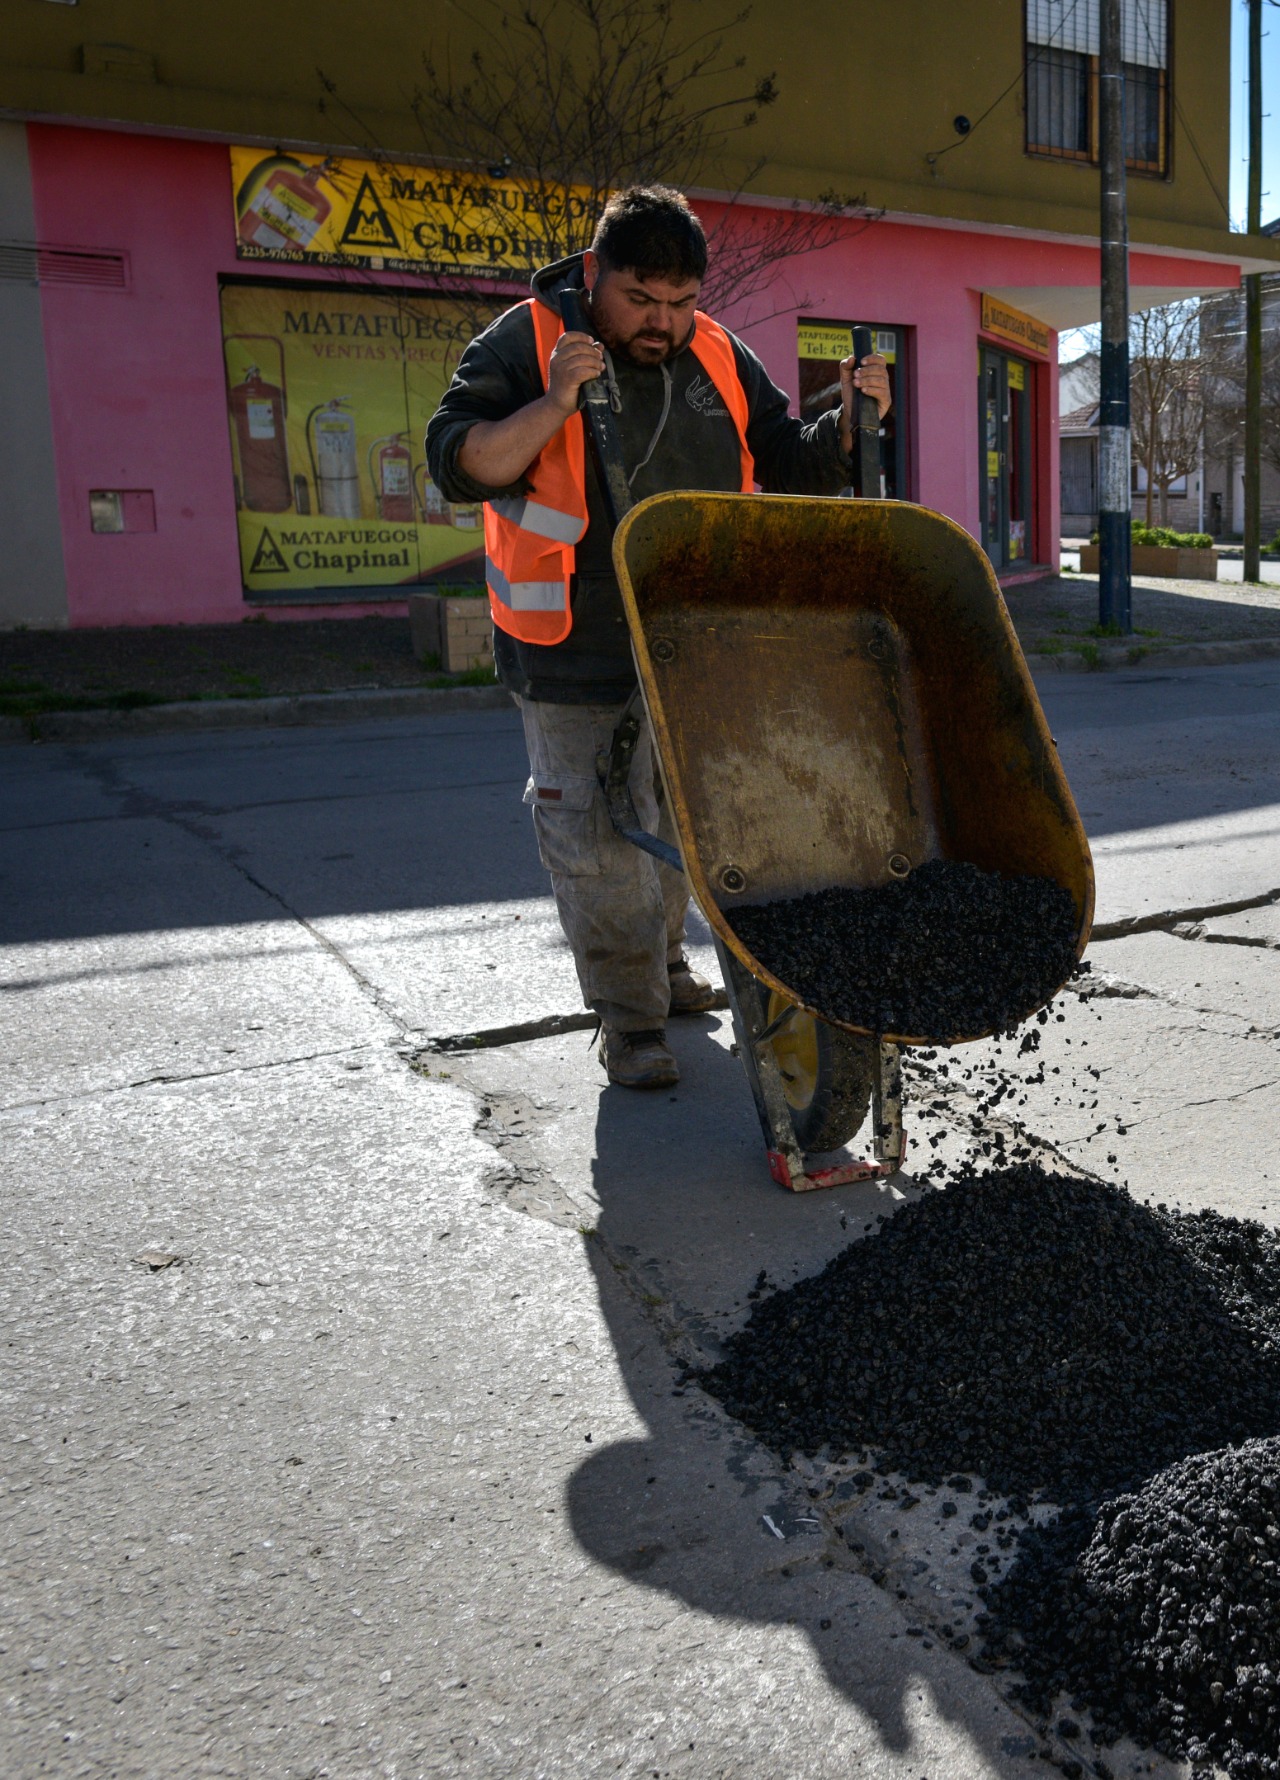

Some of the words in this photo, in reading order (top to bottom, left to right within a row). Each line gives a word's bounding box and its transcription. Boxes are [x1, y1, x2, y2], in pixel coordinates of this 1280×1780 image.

[389, 176, 603, 219] MATAFUEGOS
[797, 331, 849, 342] ATAFUEGOS
[313, 343, 386, 360] VENTAS
[393, 346, 405, 361] Y
[804, 342, 827, 355] Tel:
[280, 529, 419, 545] MATAFUEGOS
[294, 548, 410, 573] Chapinal
